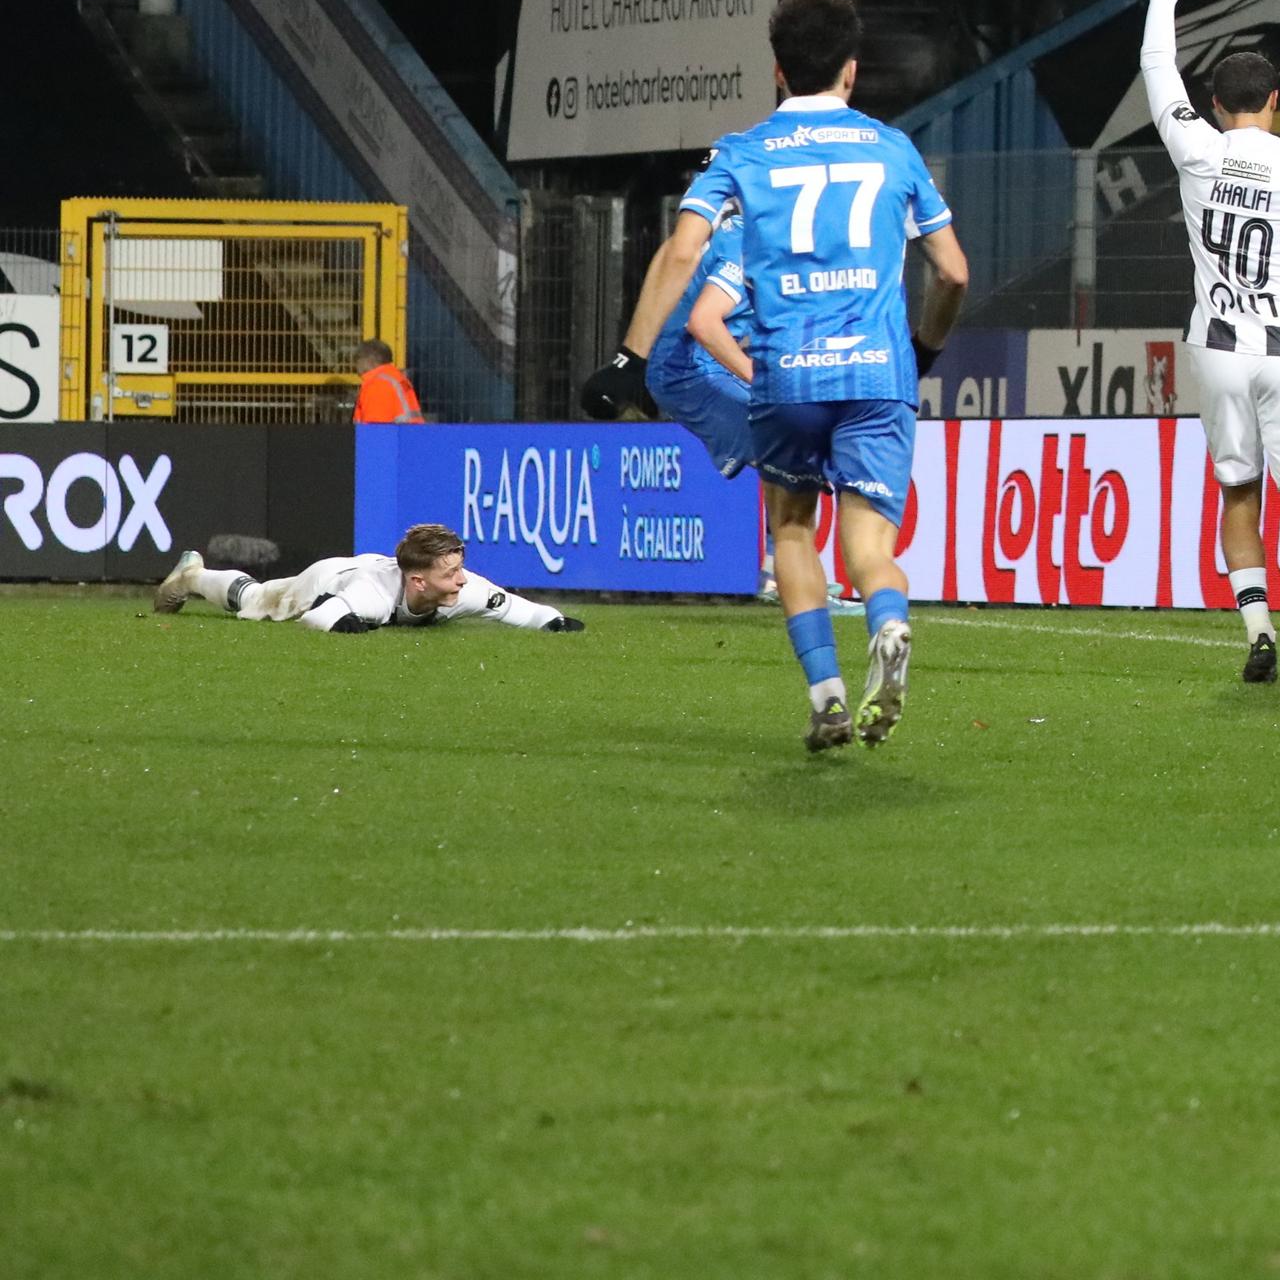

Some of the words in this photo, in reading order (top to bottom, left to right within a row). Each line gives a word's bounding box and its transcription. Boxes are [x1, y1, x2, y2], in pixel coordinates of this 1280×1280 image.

[1223, 157, 1273, 176] FONDATION
[769, 162, 885, 254] 77
[1209, 179, 1273, 213] KHALIFI
[1202, 208, 1275, 290] 40
[781, 273, 806, 296] EL
[121, 333, 158, 363] 12
[779, 348, 889, 369] CARGLASS
[620, 446, 682, 490] POMPES
[982, 418, 1131, 607] lotto
[619, 504, 632, 559] À
[634, 515, 705, 561] CHALEUR
